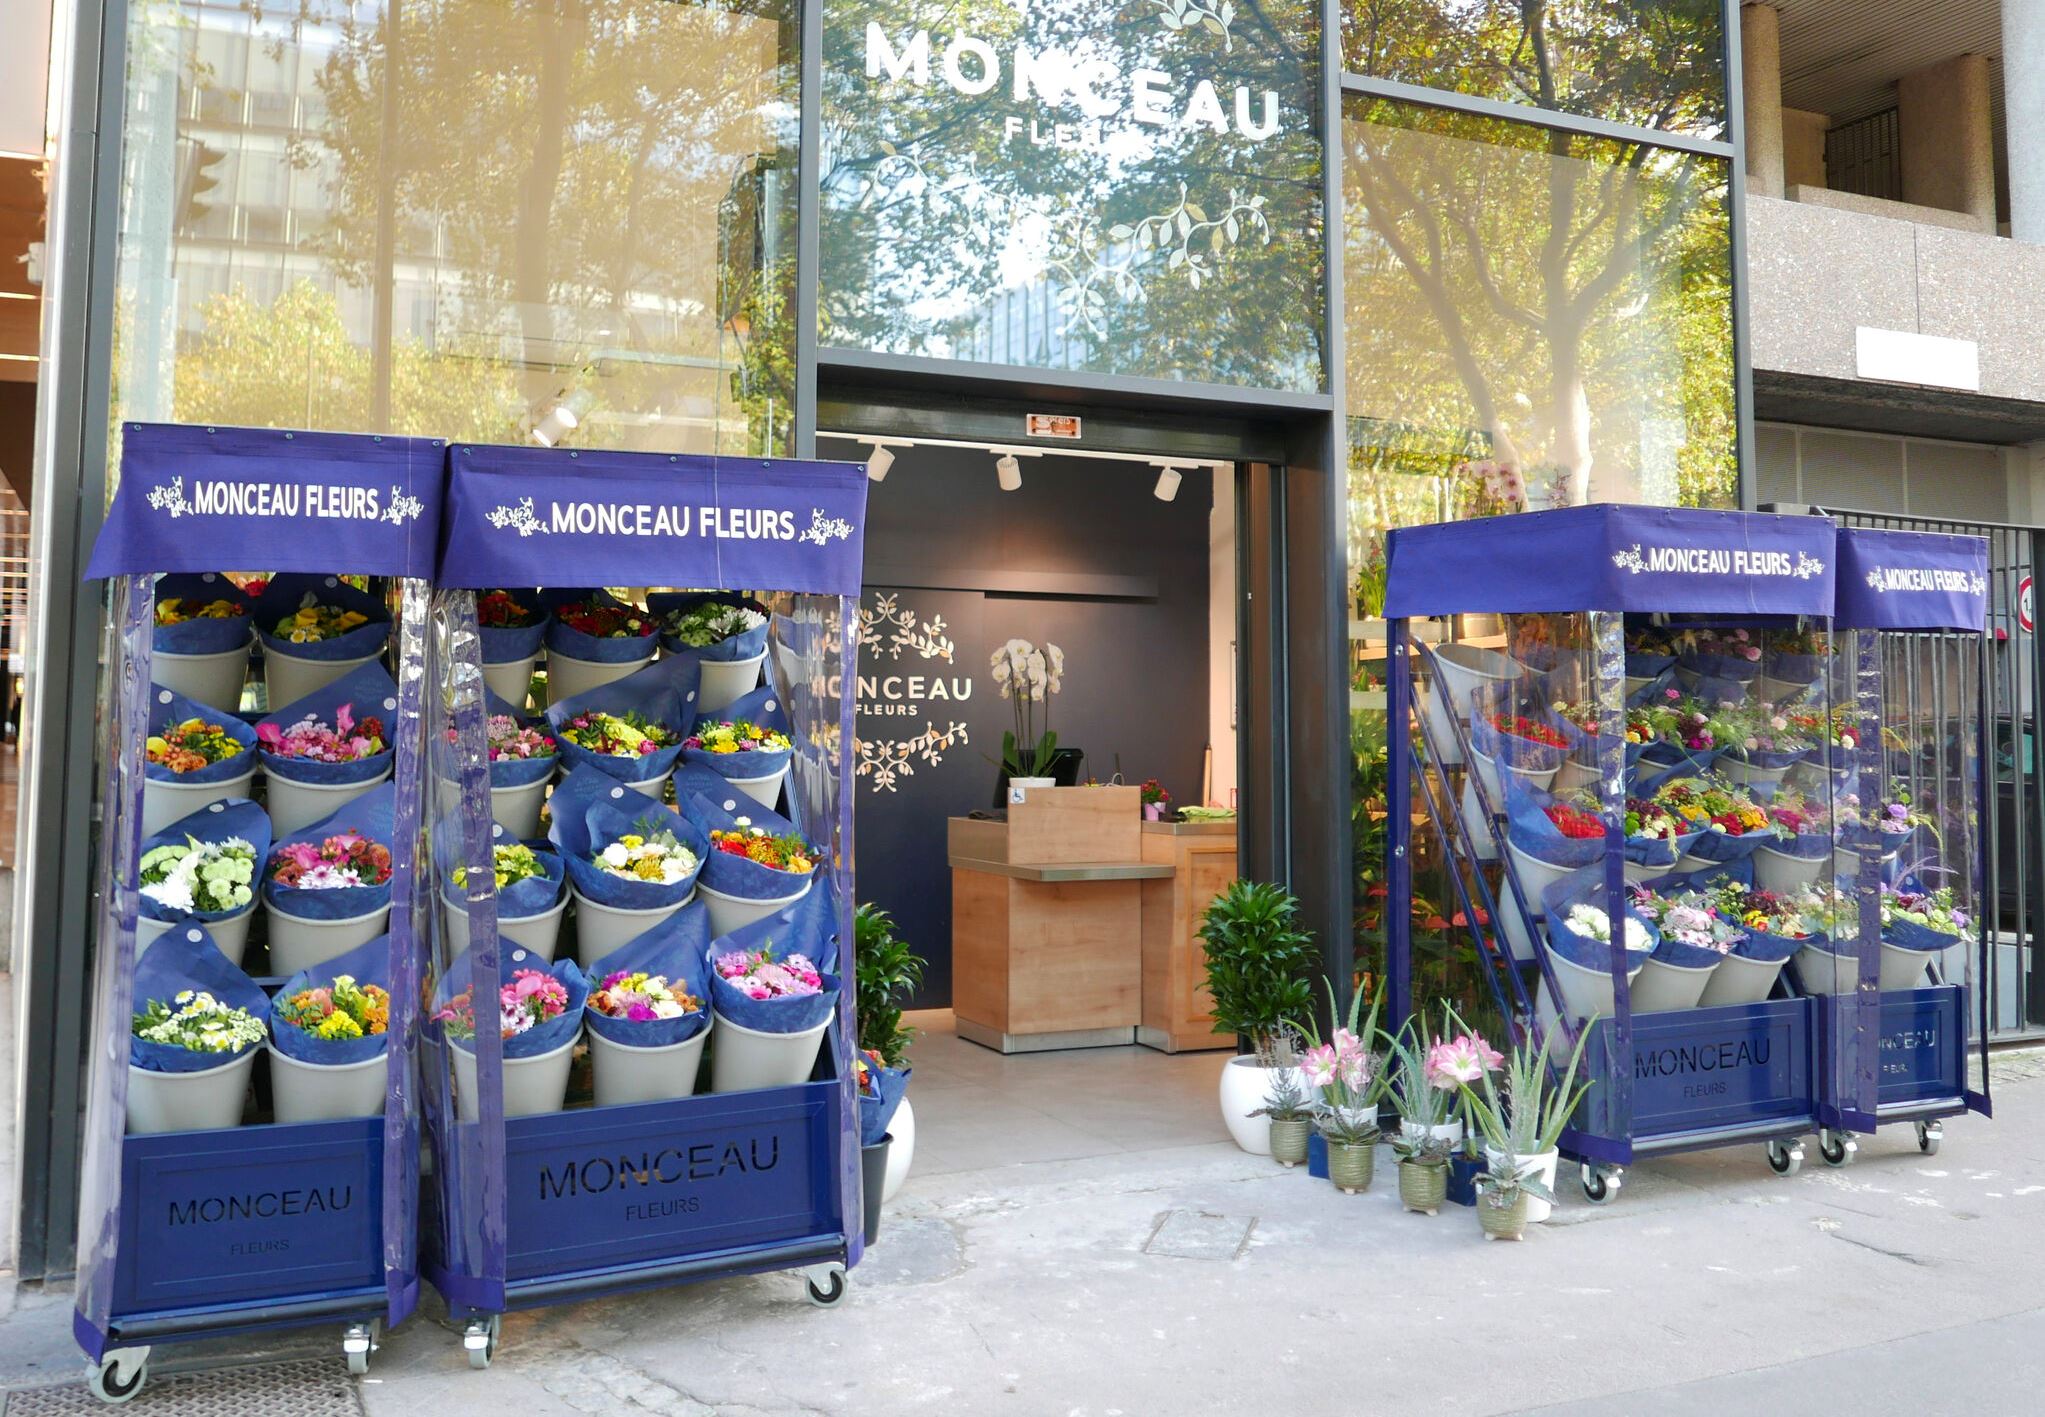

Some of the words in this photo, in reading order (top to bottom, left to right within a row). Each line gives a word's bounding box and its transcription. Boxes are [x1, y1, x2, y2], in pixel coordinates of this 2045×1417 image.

[866, 21, 1279, 141] MONCEAU
[194, 480, 300, 520] MONCEAU
[305, 484, 379, 520] FLEURS
[551, 501, 690, 537] MONCEAU
[699, 505, 795, 541] FLEURS
[1649, 548, 1731, 574] MONCEAU
[1735, 551, 1792, 576] FLEURS
[1886, 569, 1933, 592] MONCEAU
[1934, 571, 1969, 593] FLEURS
[855, 704, 918, 716] FLEURS
[1634, 1038, 1771, 1079] MONCEAU
[1683, 1082, 1726, 1098] FLEURS
[539, 1135, 780, 1201] MONCEAU
[168, 1185, 352, 1226] MONCEAU
[625, 1197, 700, 1222] FLEURS
[230, 1238, 289, 1256] FLEURS
